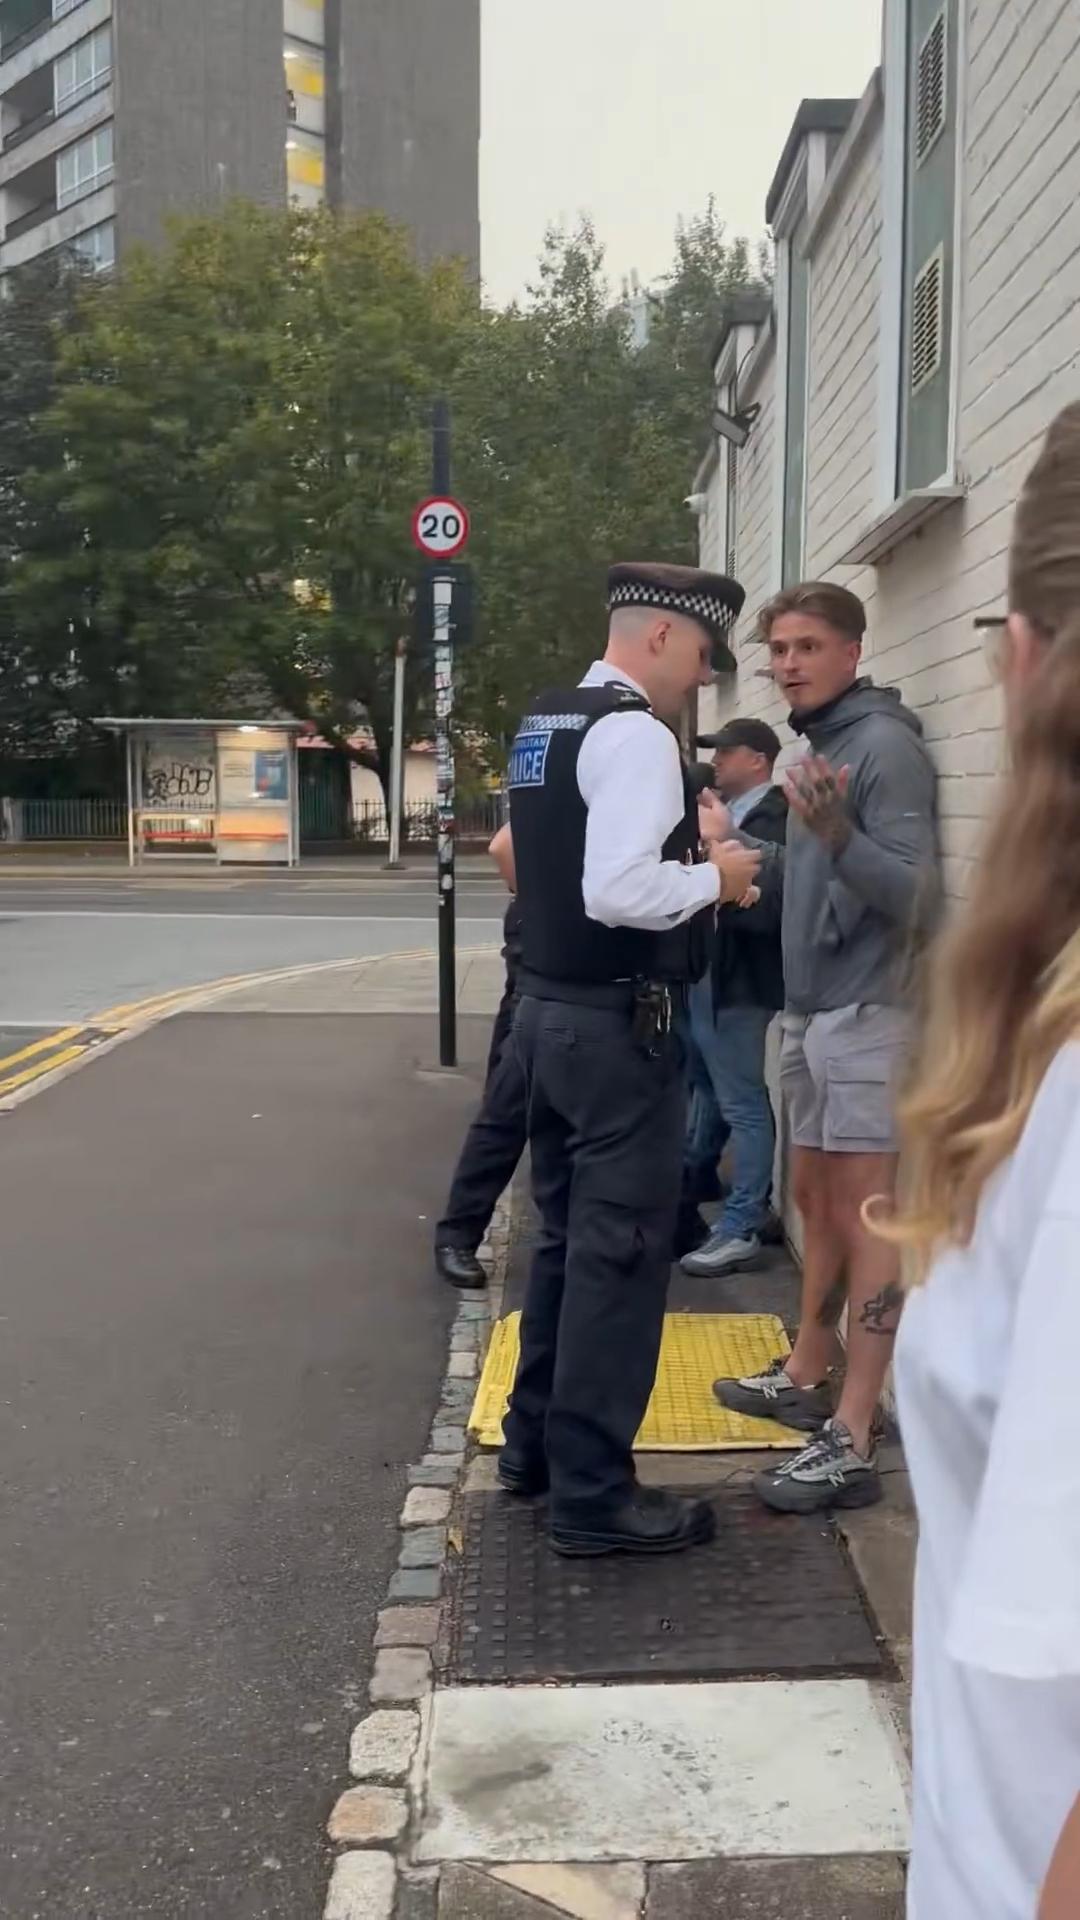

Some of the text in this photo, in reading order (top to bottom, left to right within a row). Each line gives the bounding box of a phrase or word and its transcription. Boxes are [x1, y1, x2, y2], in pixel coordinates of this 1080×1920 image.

[422, 514, 460, 539] 20
[762, 1384, 778, 1399] N
[828, 1470, 846, 1487] N
